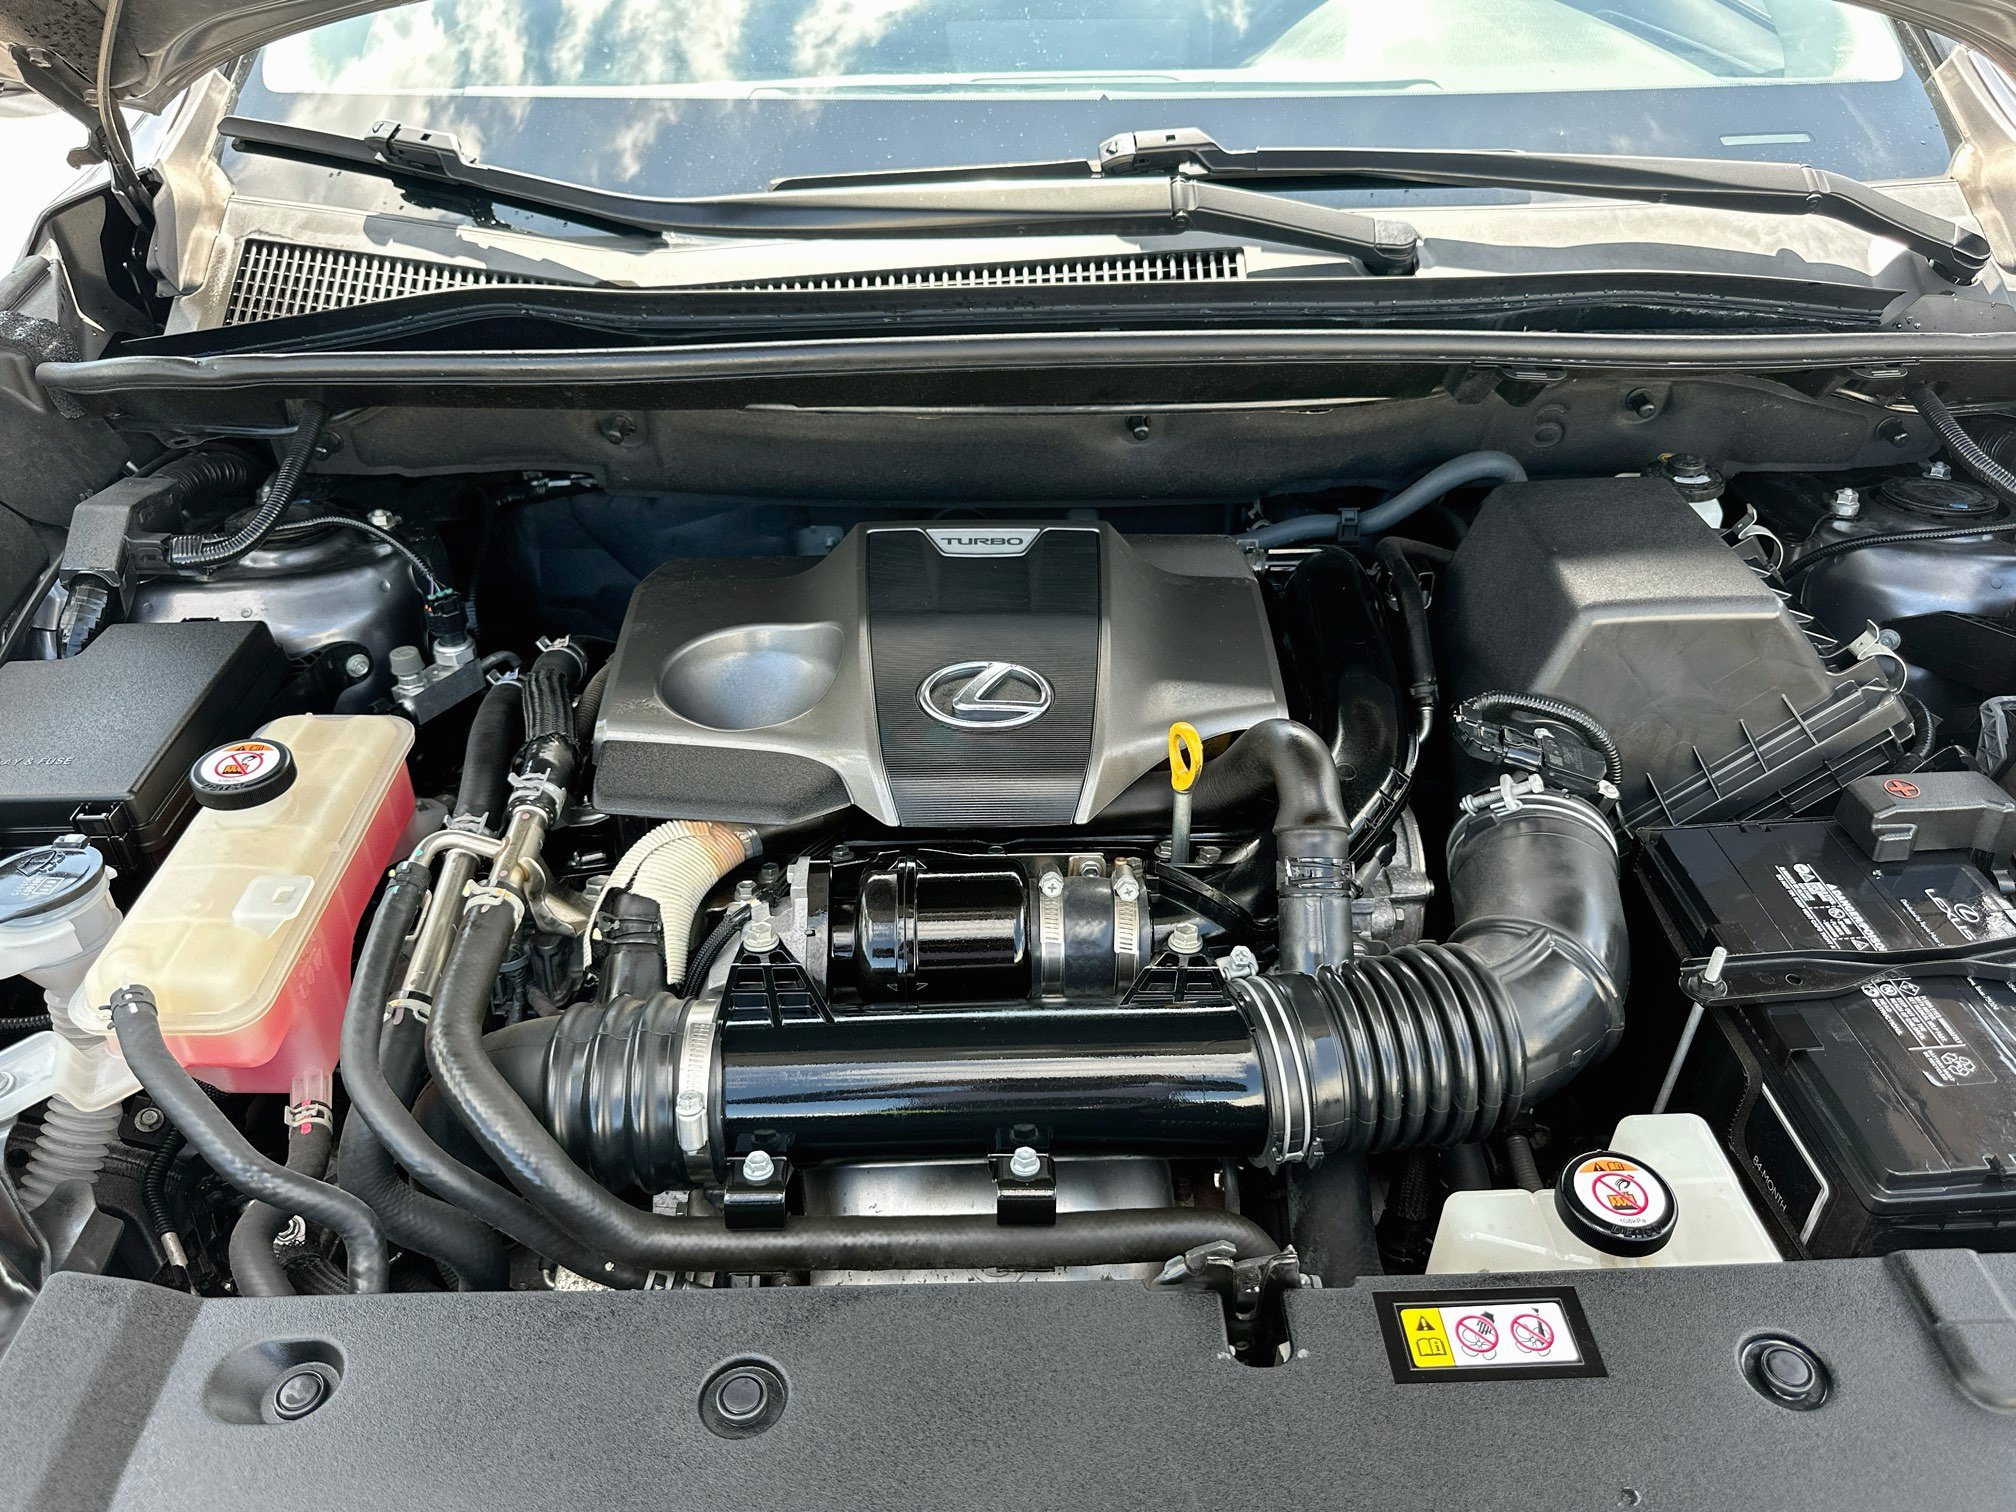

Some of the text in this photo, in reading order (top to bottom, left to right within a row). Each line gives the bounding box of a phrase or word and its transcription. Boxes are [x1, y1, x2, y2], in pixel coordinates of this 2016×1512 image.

[940, 537, 1024, 546] TURBO
[0, 756, 76, 766] AY & FUSE
[1832, 890, 1887, 951] DANGER/POISO
[1924, 888, 1977, 941] LEXUS
